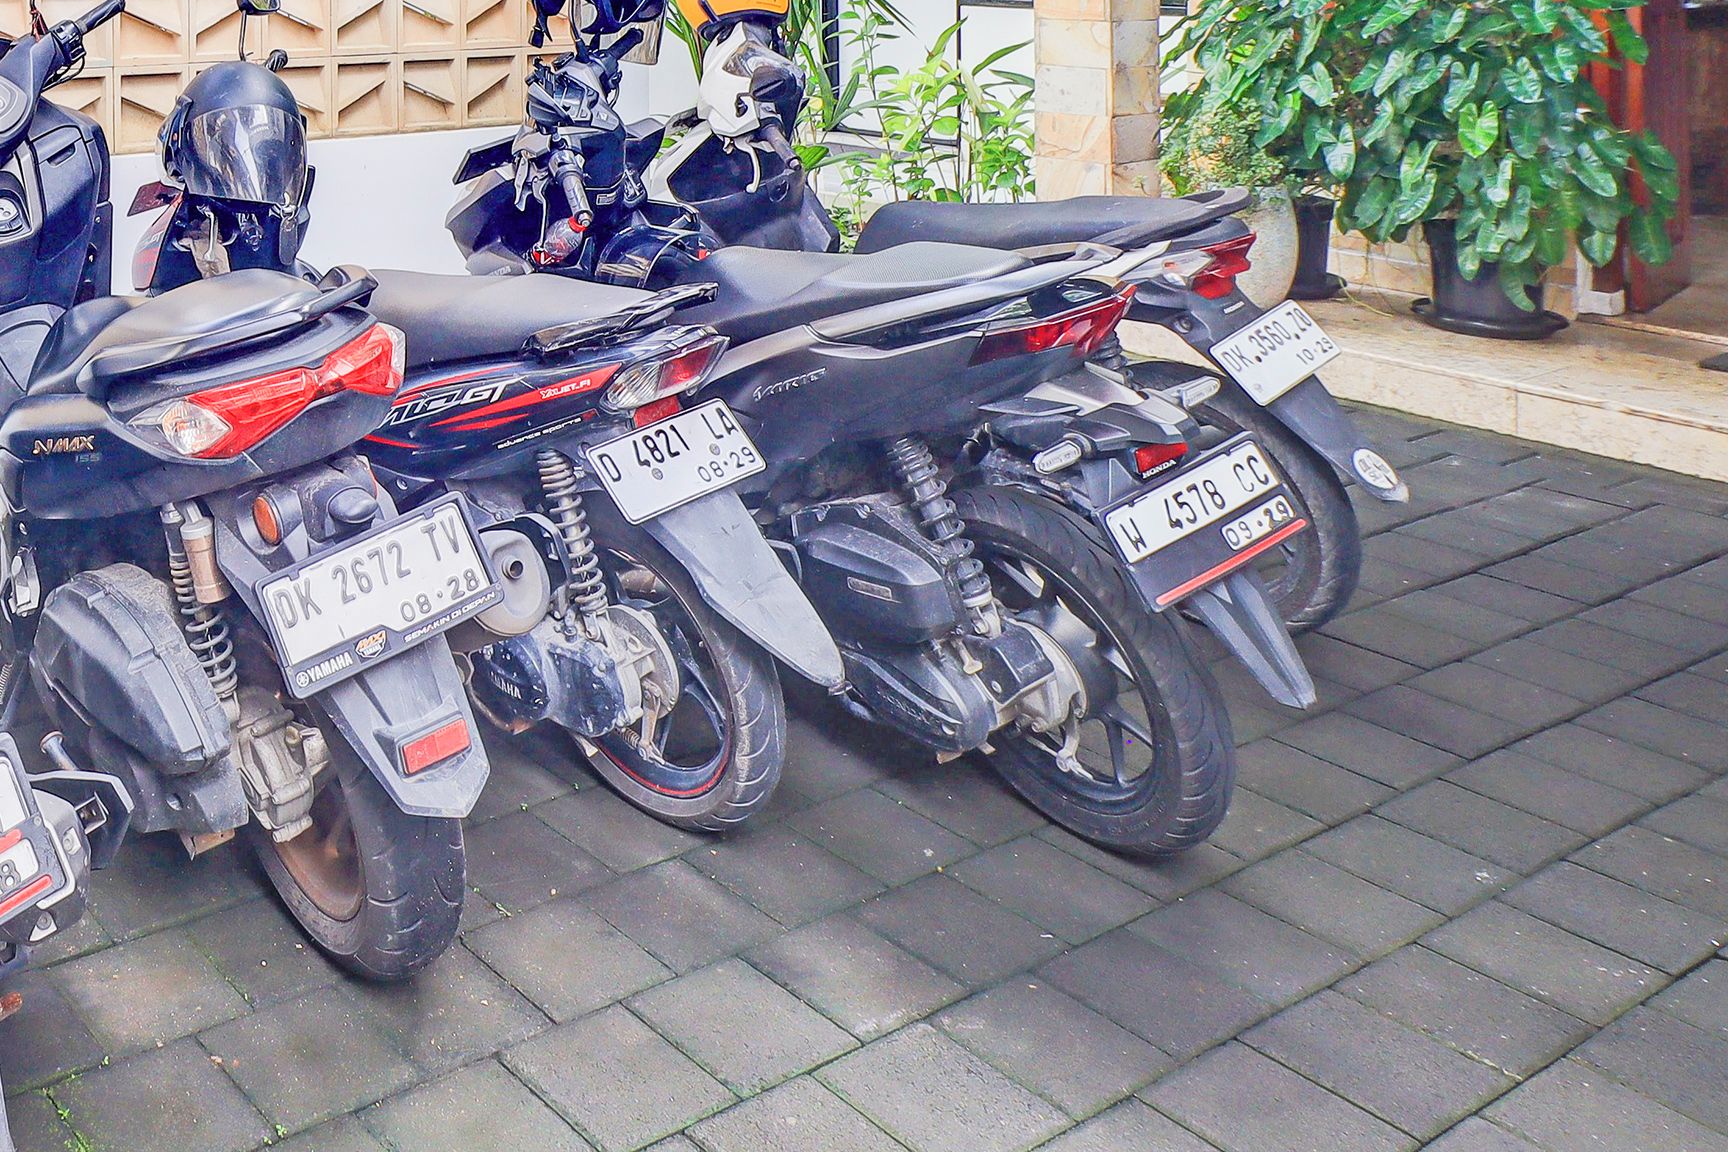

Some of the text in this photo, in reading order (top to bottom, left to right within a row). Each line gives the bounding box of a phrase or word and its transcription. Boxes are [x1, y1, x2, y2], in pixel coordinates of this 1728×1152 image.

[597, 407, 739, 483] D 4821 LA
[1142, 459, 1177, 479] HONDA
[1120, 455, 1269, 553] W 4578 CC
[274, 515, 460, 628] DK 2672 TV
[404, 591, 495, 643] SEMAKIN DI DEPAN
[307, 652, 353, 682] YAMAHA
